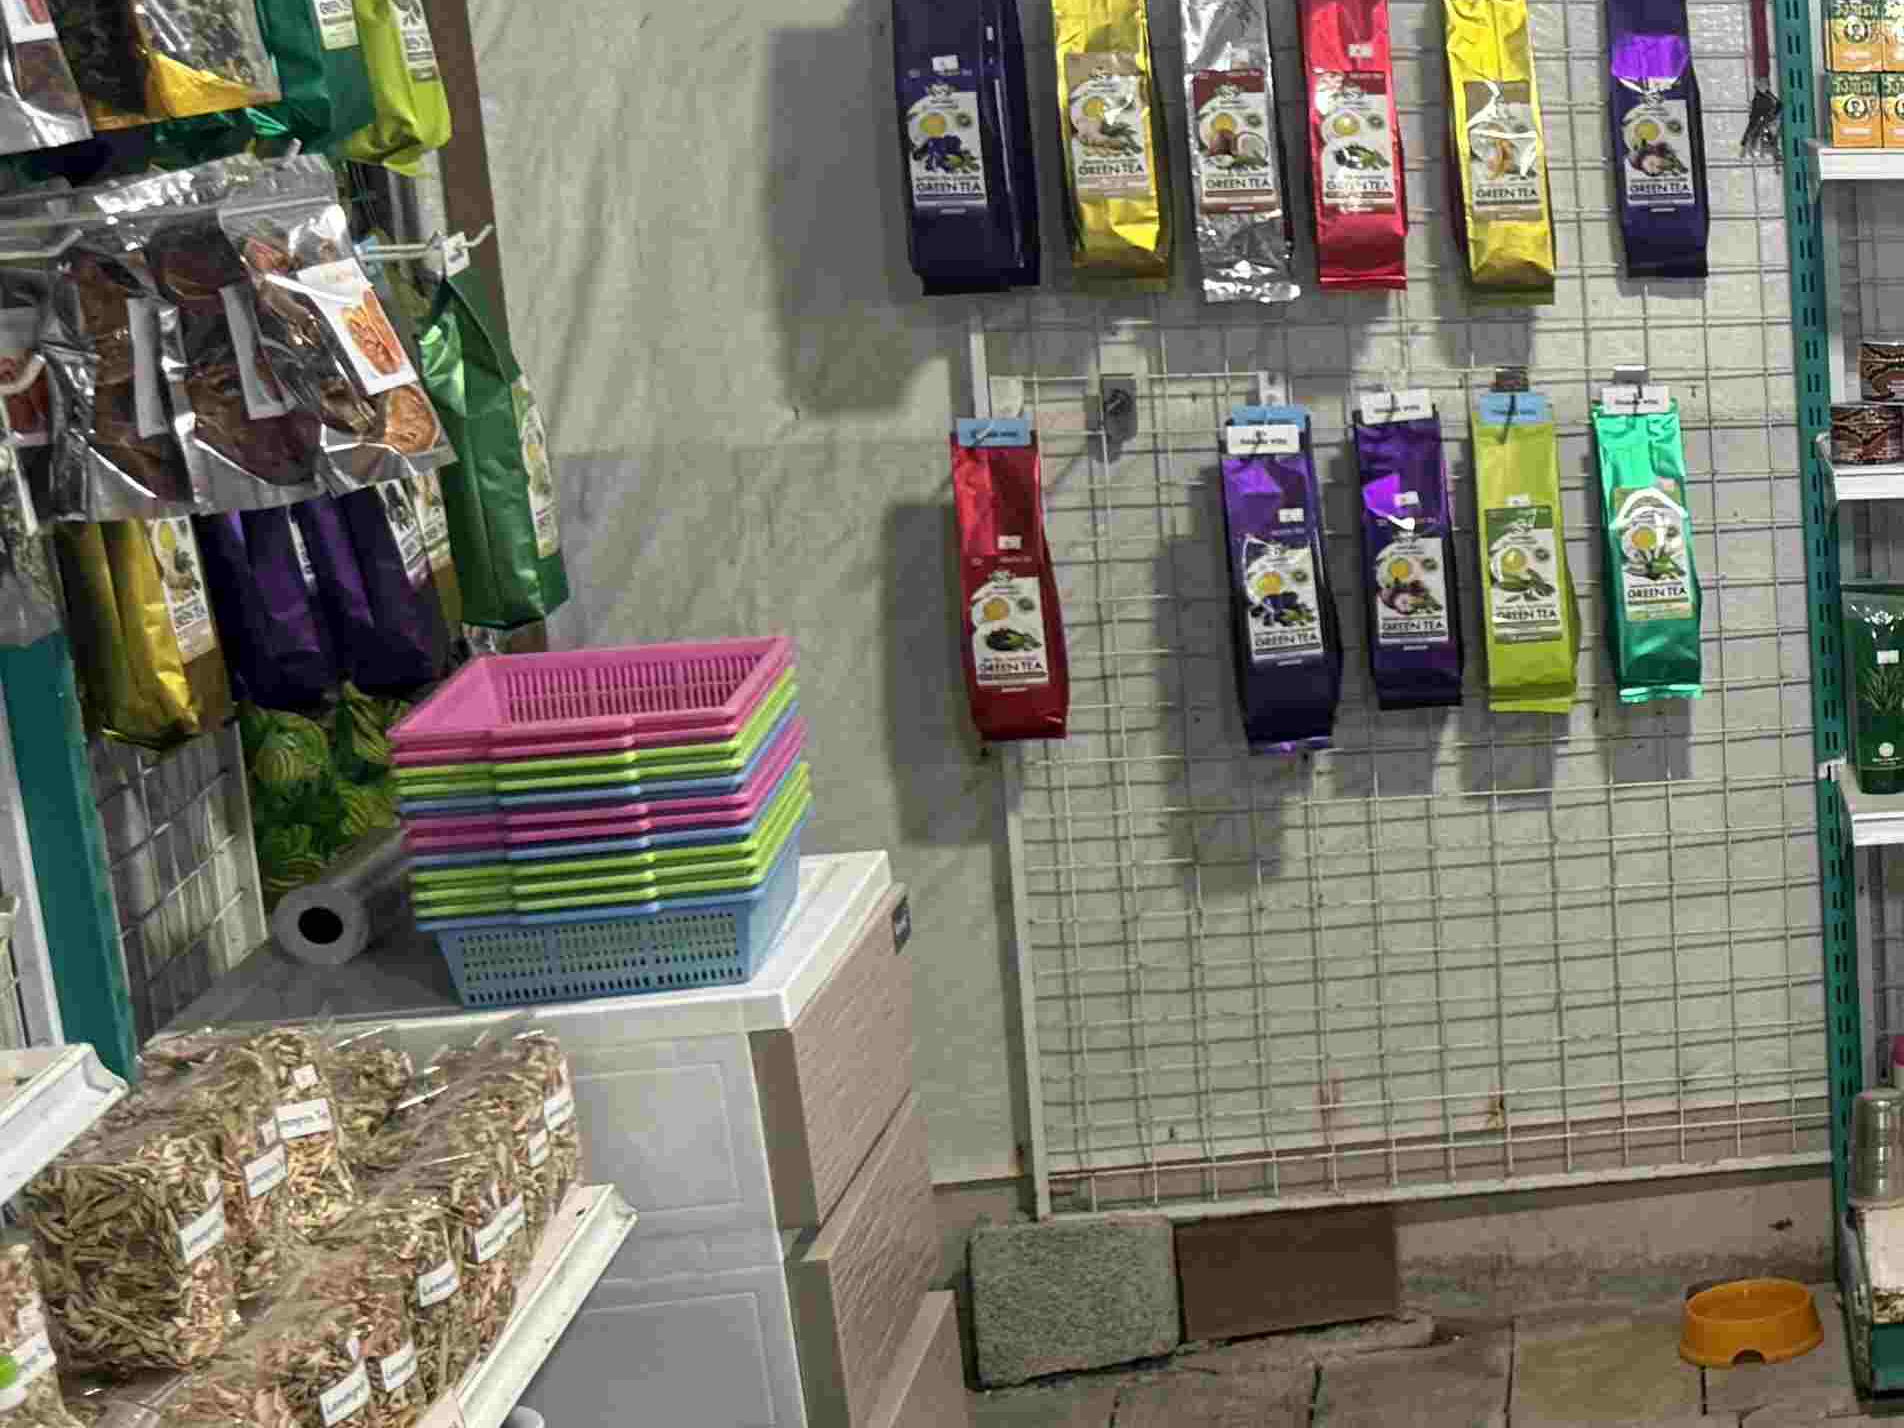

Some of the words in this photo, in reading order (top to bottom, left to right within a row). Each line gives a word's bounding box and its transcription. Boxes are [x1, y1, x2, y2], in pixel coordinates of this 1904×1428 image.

[1078, 165, 1119, 176] GREEN
[1121, 164, 1144, 175] TEA
[962, 180, 982, 191] TEA
[1206, 179, 1247, 190] GREEN
[1250, 178, 1271, 189] TEA
[1364, 179, 1390, 190] TEA
[1672, 183, 1690, 193] TEA
[1475, 187, 1516, 199] GREEN
[1518, 187, 1538, 198] TEA
[1627, 588, 1665, 600] GREEN
[1667, 587, 1688, 598] TEA
[1537, 609, 1558, 620] TEA
[1423, 620, 1444, 631] TEA
[1298, 632, 1319, 645] TEA
[1021, 660, 1044, 673] TEA
